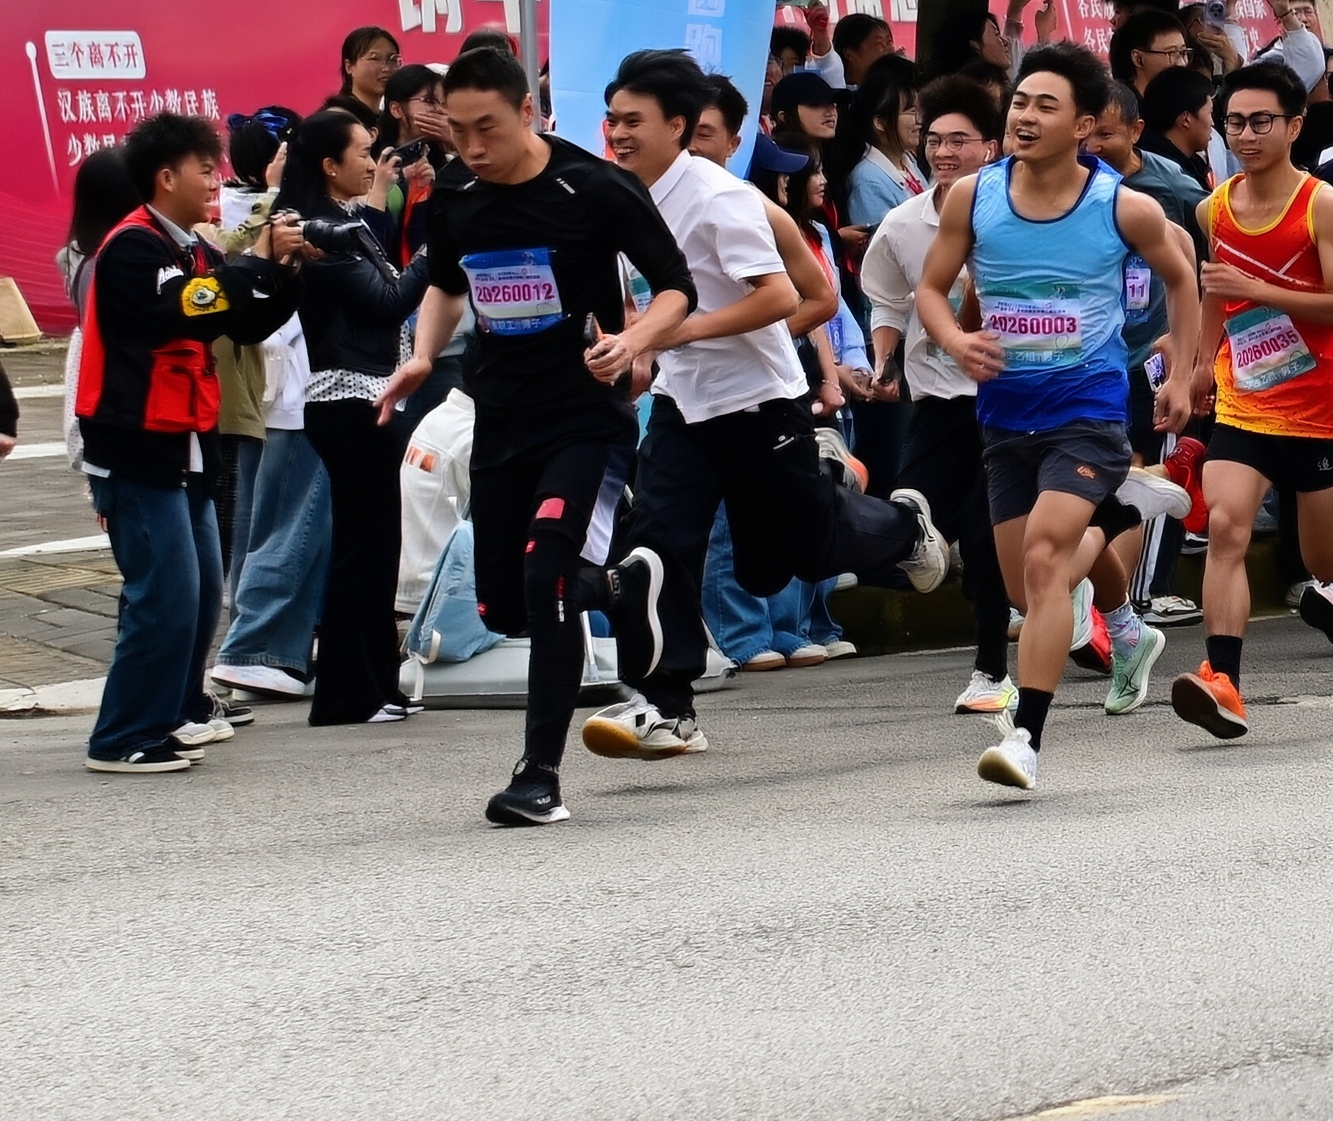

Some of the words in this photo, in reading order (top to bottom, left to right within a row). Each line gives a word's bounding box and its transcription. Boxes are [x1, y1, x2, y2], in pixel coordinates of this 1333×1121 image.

[52, 42, 139, 69] 三个离不开
[475, 282, 556, 303] 20260012
[989, 314, 1077, 335] 20260003
[1236, 330, 1300, 368] 20260035
